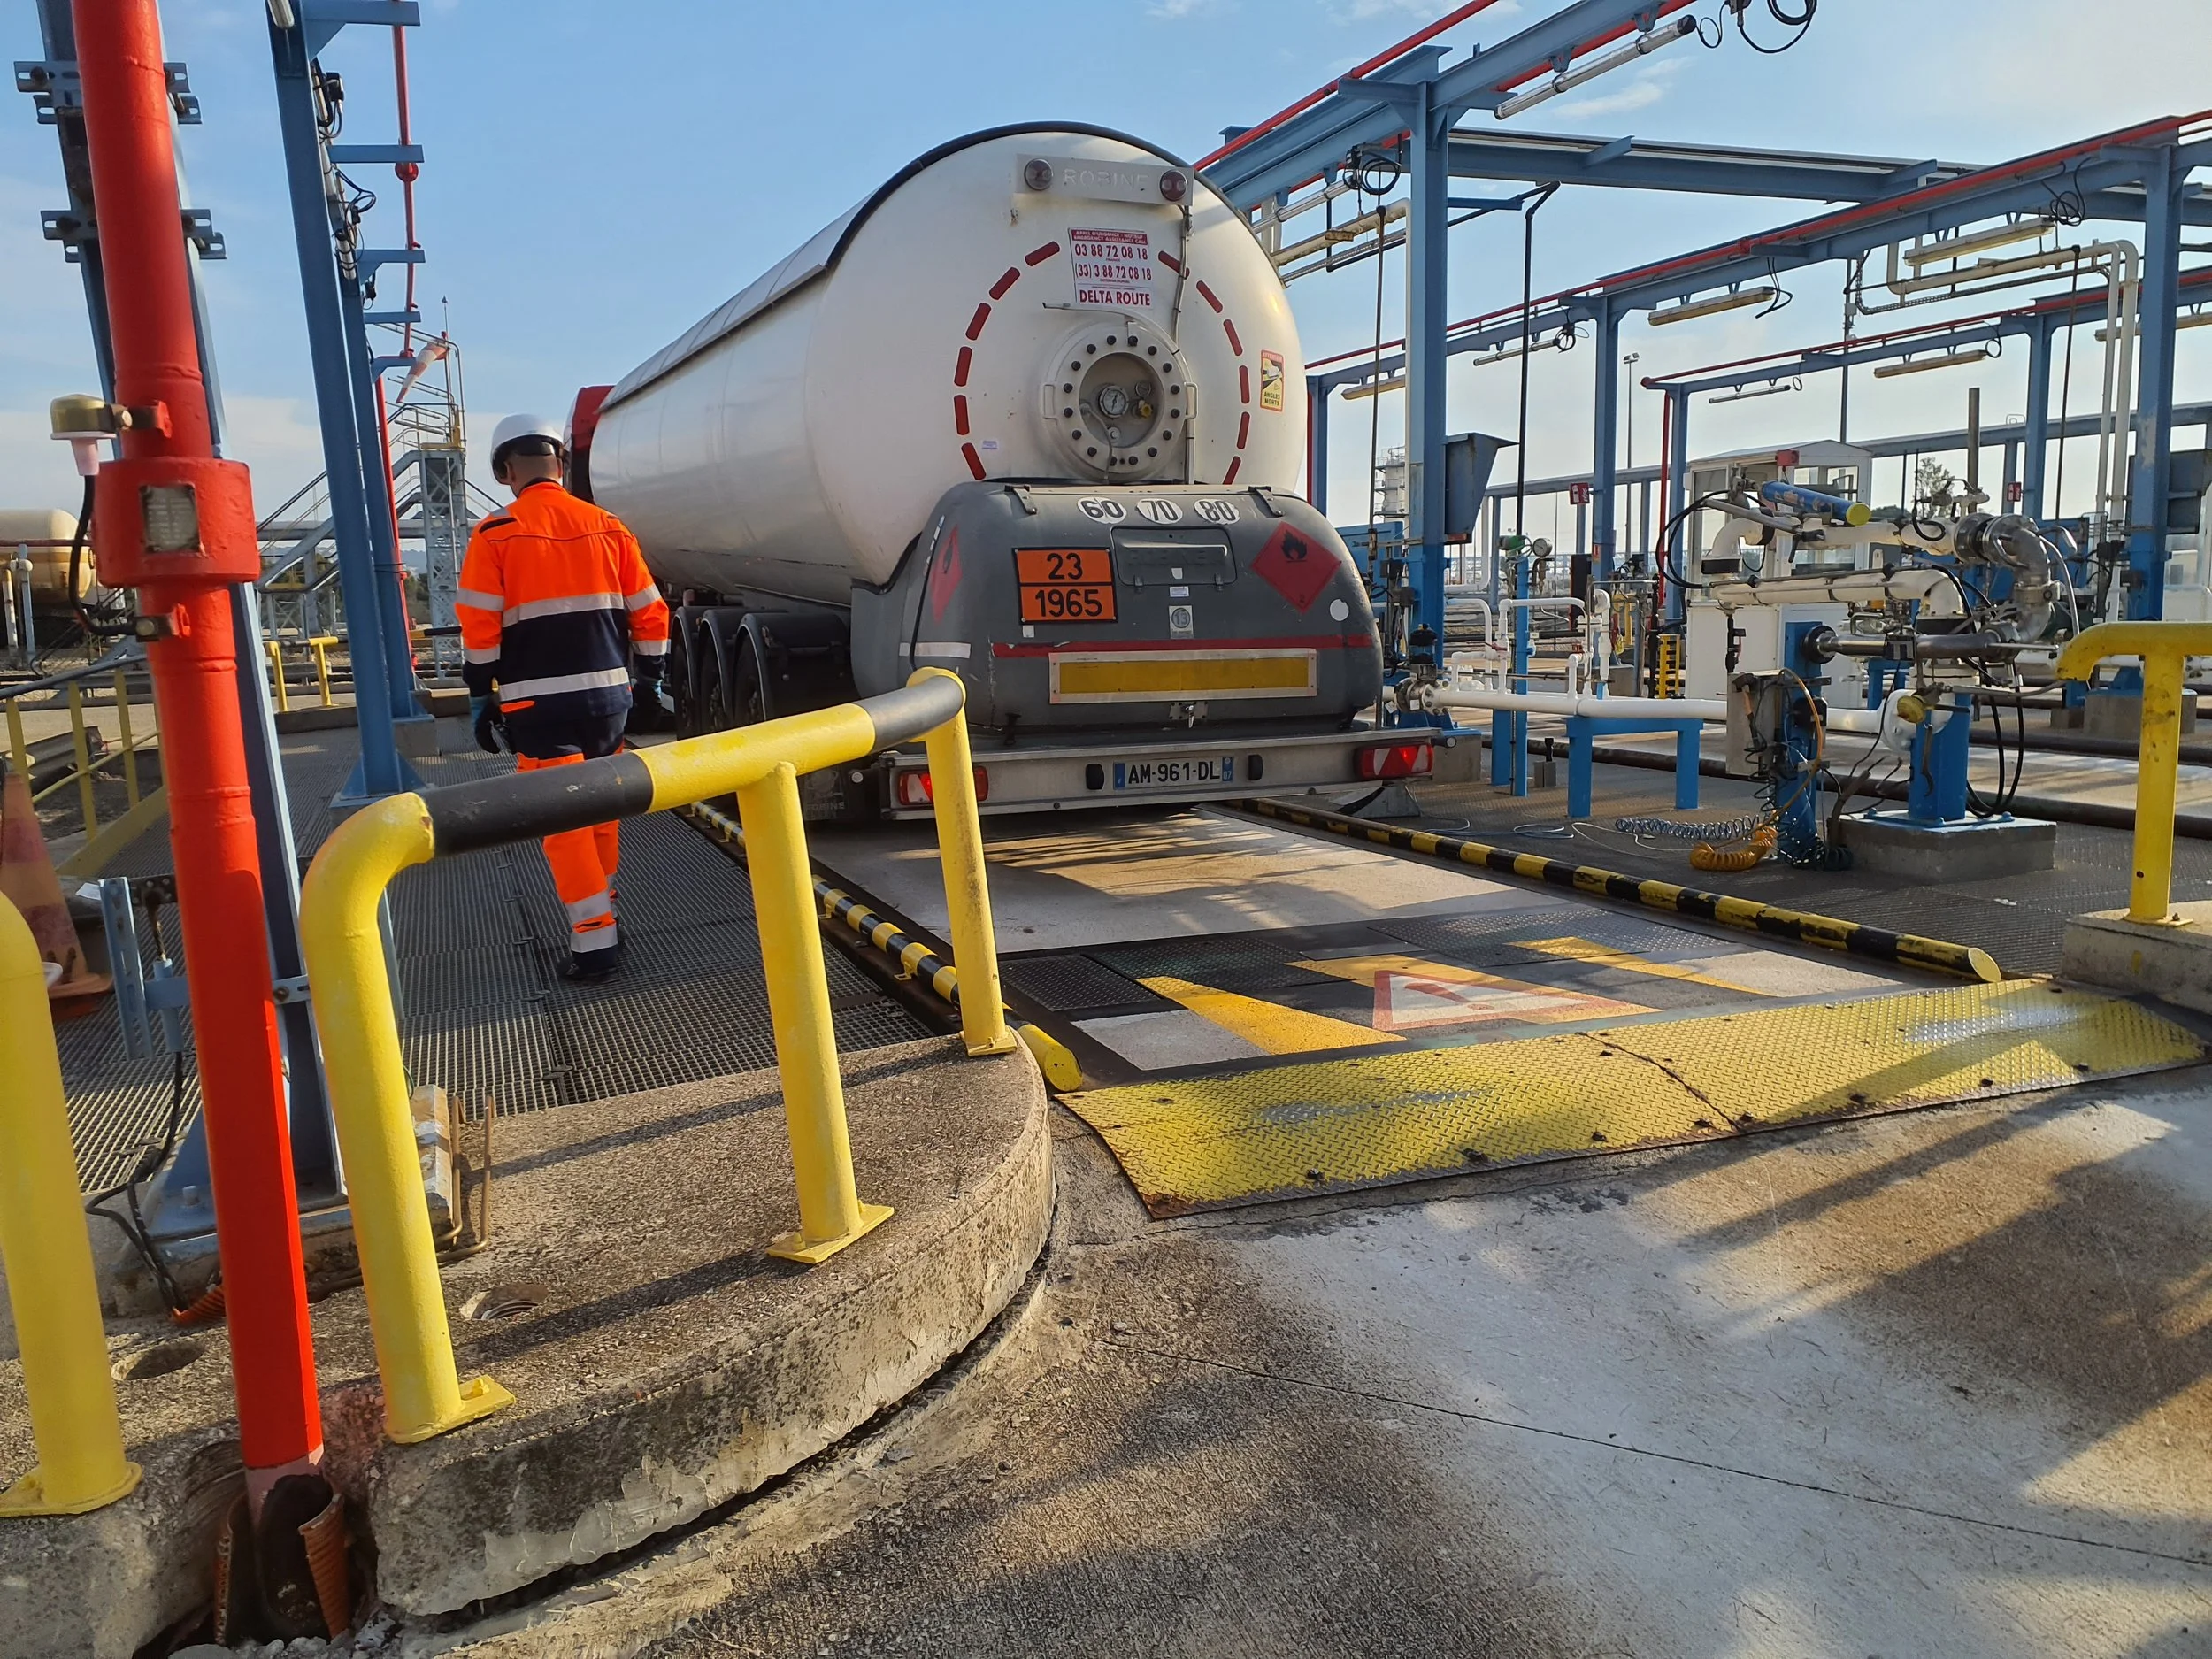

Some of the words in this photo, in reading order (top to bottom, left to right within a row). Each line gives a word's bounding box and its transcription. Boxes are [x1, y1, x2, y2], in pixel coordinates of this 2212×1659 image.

[1075, 243, 1087, 257] 03
[1090, 244, 1103, 257] 88
[1106, 245, 1119, 257] 72
[1121, 246, 1133, 259] 08
[1137, 248, 1148, 260] 18
[1075, 263, 1092, 279] (33)
[1094, 265, 1100, 278] 3
[1102, 265, 1113, 278] 88
[1115, 265, 1126, 279] 72
[1128, 266, 1139, 280] 08
[1141, 267, 1152, 280] 18
[1079, 289, 1113, 304] DELTA
[1116, 291, 1150, 306] ROUTE
[1080, 500, 1124, 518] 60
[1141, 500, 1179, 521] 70
[1199, 500, 1236, 521] 80
[1047, 552, 1083, 580] 23
[1035, 588, 1102, 618] 1965
[1174, 611, 1188, 626] 13
[1128, 760, 1220, 785] AM-961-DL
[1223, 770, 1232, 780] 07
